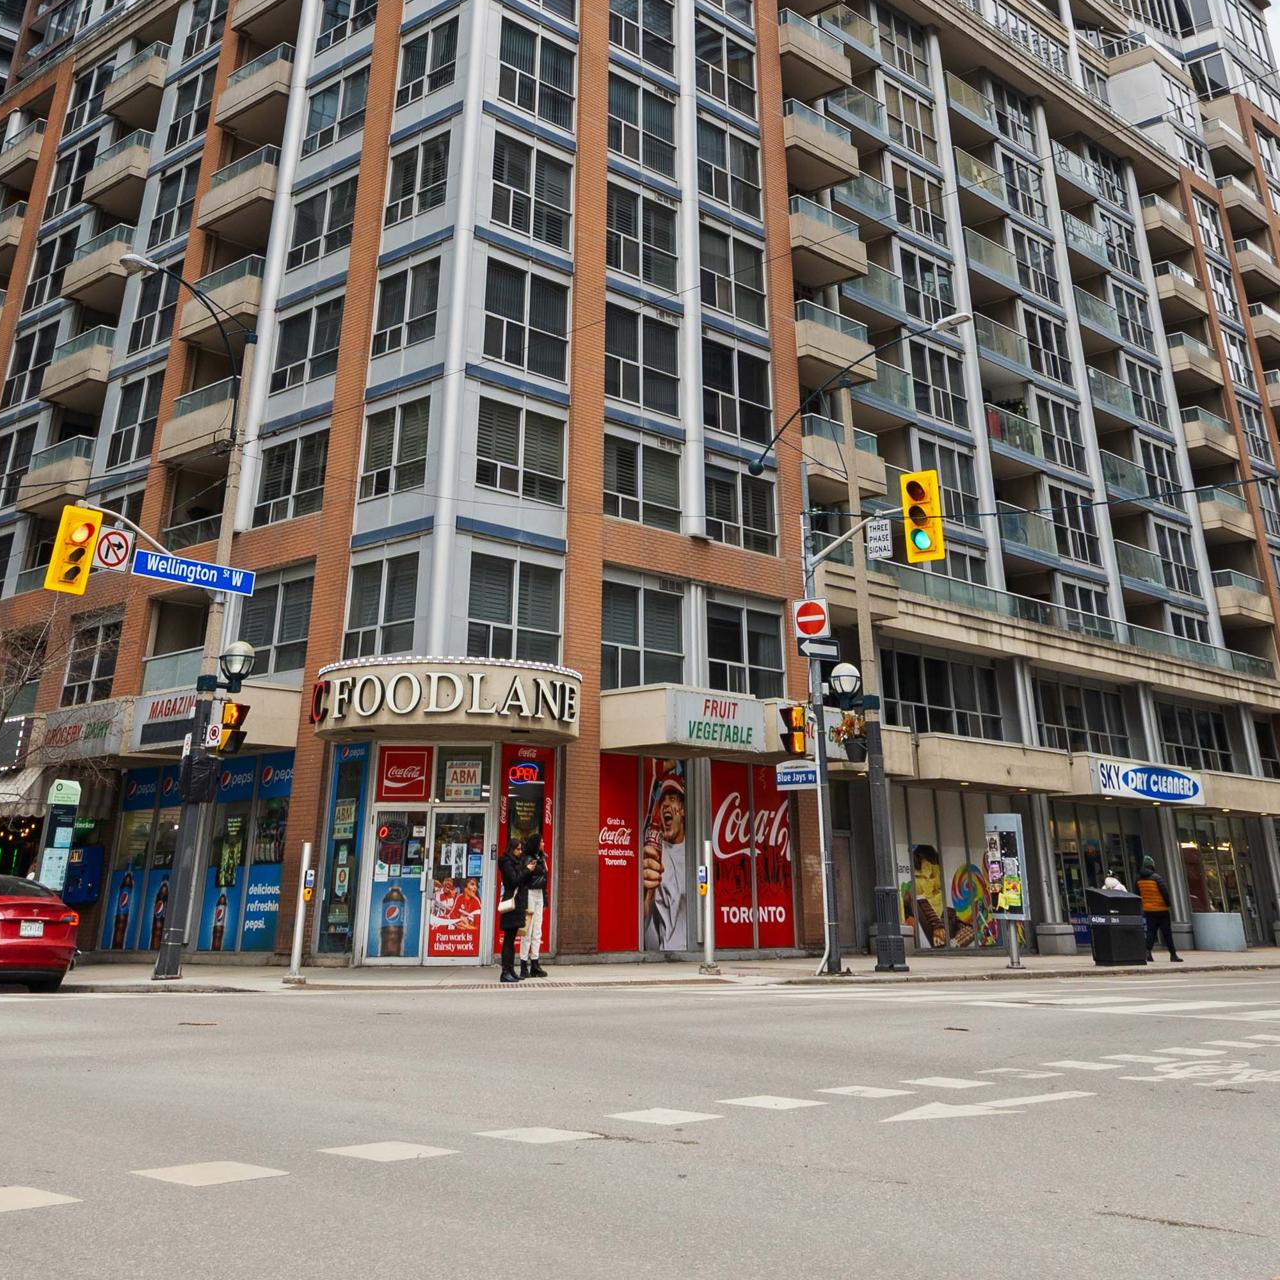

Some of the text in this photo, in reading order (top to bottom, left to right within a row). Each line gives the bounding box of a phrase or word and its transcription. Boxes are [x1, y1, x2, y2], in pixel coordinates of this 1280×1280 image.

[869, 523, 888, 532] THREE
[869, 534, 889, 543] PHASE
[869, 545, 891, 554] SIGNAL
[147, 554, 244, 587] Wellington St W
[332, 672, 577, 723] FOODLANE
[148, 695, 196, 720] MAGAZIN
[703, 698, 738, 720] FRUIT
[45, 723, 82, 747] GROCERY
[688, 720, 753, 745] VEGETABLE
[231, 771, 254, 786] pepsi
[273, 768, 294, 783] peps
[450, 769, 477, 784] ABM
[509, 766, 538, 782] OPEN
[777, 771, 791, 782] Blue
[792, 771, 806, 783] Jays
[1100, 763, 1194, 796] SKY DRY CLEANERS
[136, 782, 157, 795] pepsi
[335, 805, 353, 821] ABM
[607, 817, 618, 825] Grab
[605, 858, 627, 866] Toronto
[246, 901, 279, 912] refreshin
[436, 932, 473, 941] Fan work is
[434, 941, 474, 952] thirsty work
